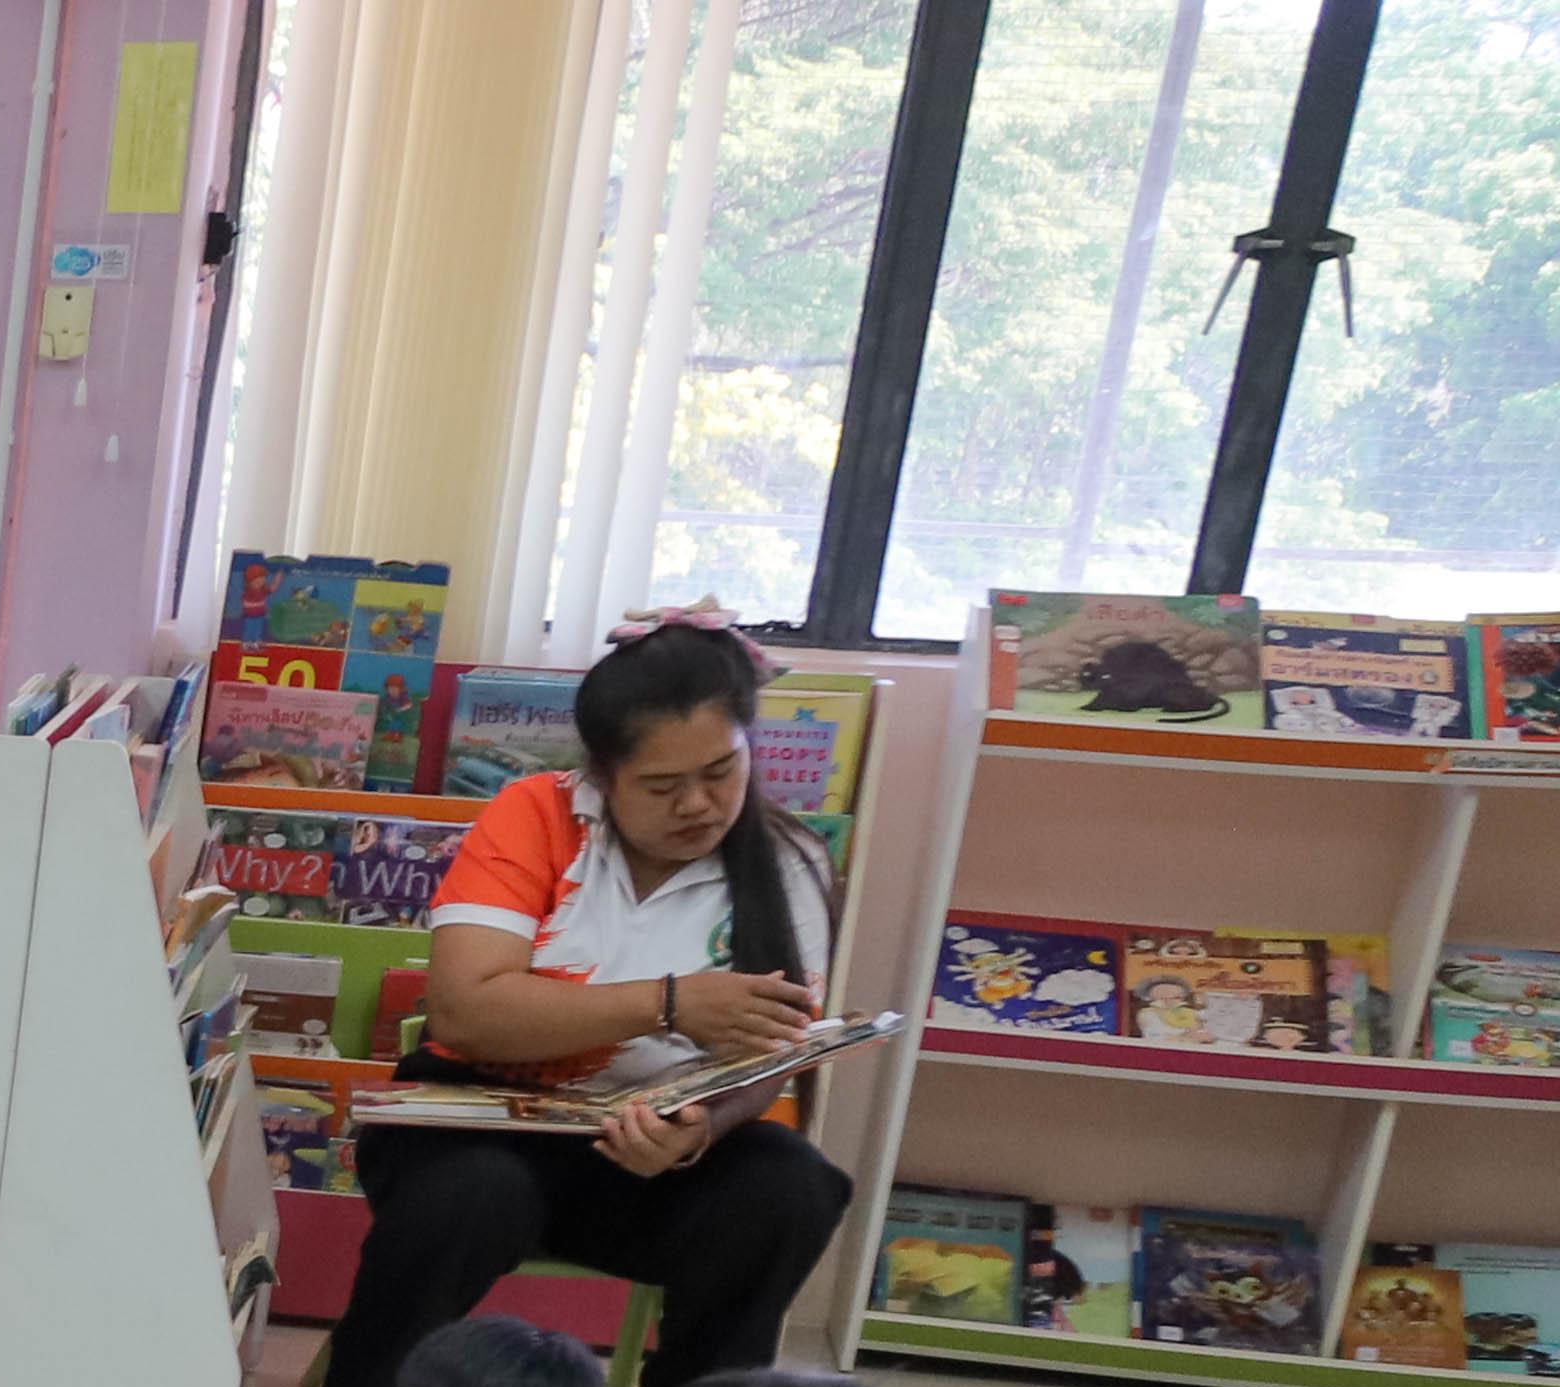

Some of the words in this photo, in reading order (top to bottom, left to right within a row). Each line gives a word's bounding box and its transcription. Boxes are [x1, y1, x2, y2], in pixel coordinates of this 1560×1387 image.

[758, 747, 827, 761] ESOP'S
[767, 767, 821, 783] BLES
[216, 848, 322, 892] Why?
